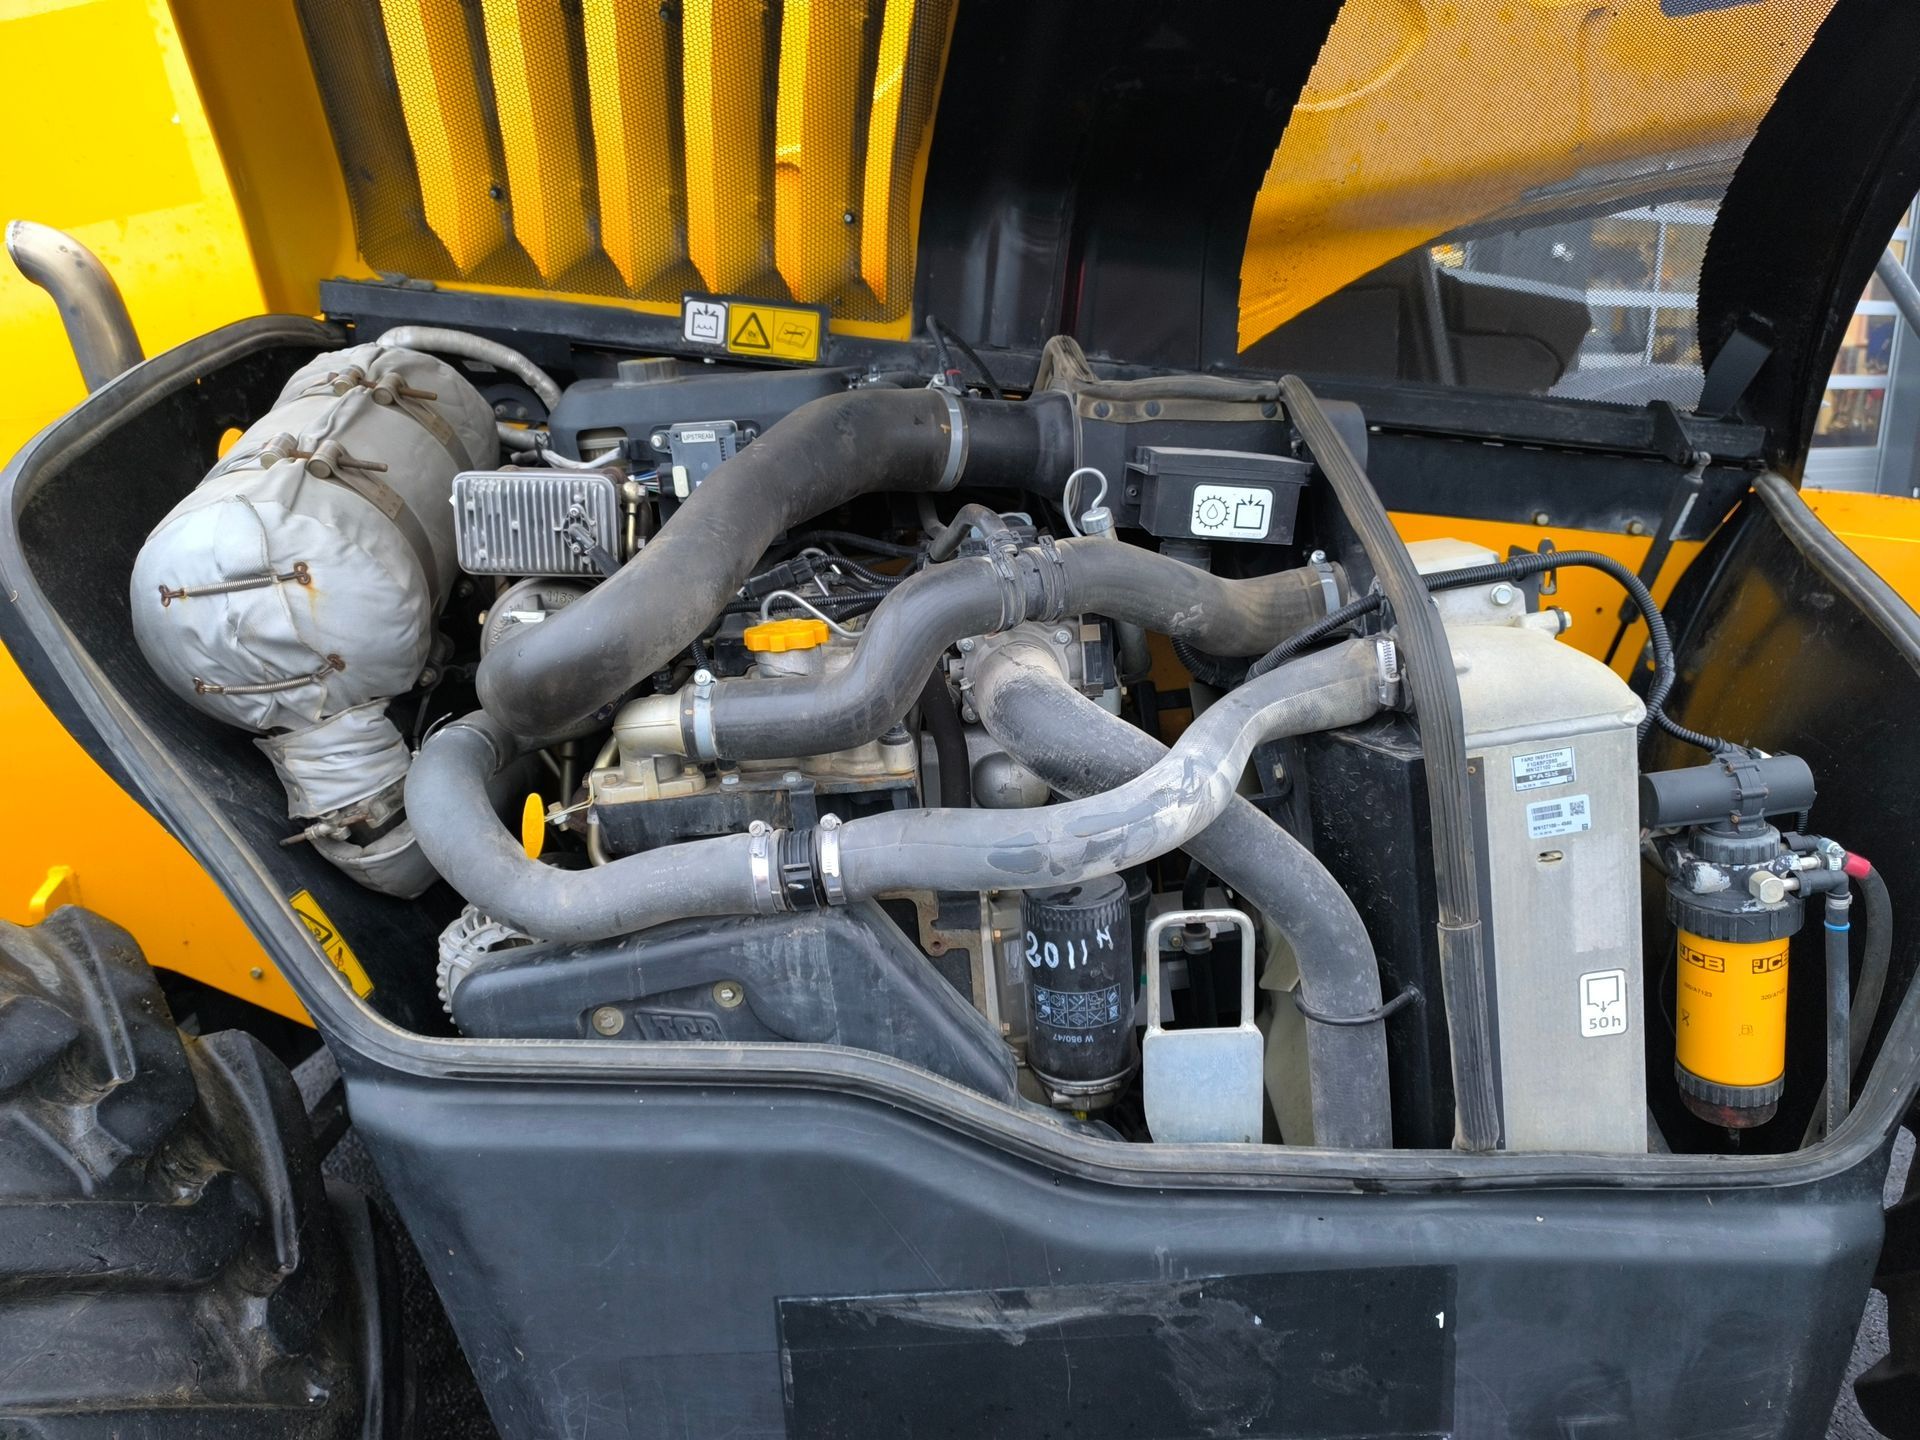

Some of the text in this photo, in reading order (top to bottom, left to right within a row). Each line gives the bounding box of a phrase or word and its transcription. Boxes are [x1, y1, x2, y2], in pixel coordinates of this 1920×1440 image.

[683, 432, 714, 442] UPSTREAM
[1529, 771, 1559, 781] PASS
[1025, 929, 1088, 970] 2011
[1680, 944, 1724, 973] JCB
[1053, 1033, 1082, 1043] 950/47
